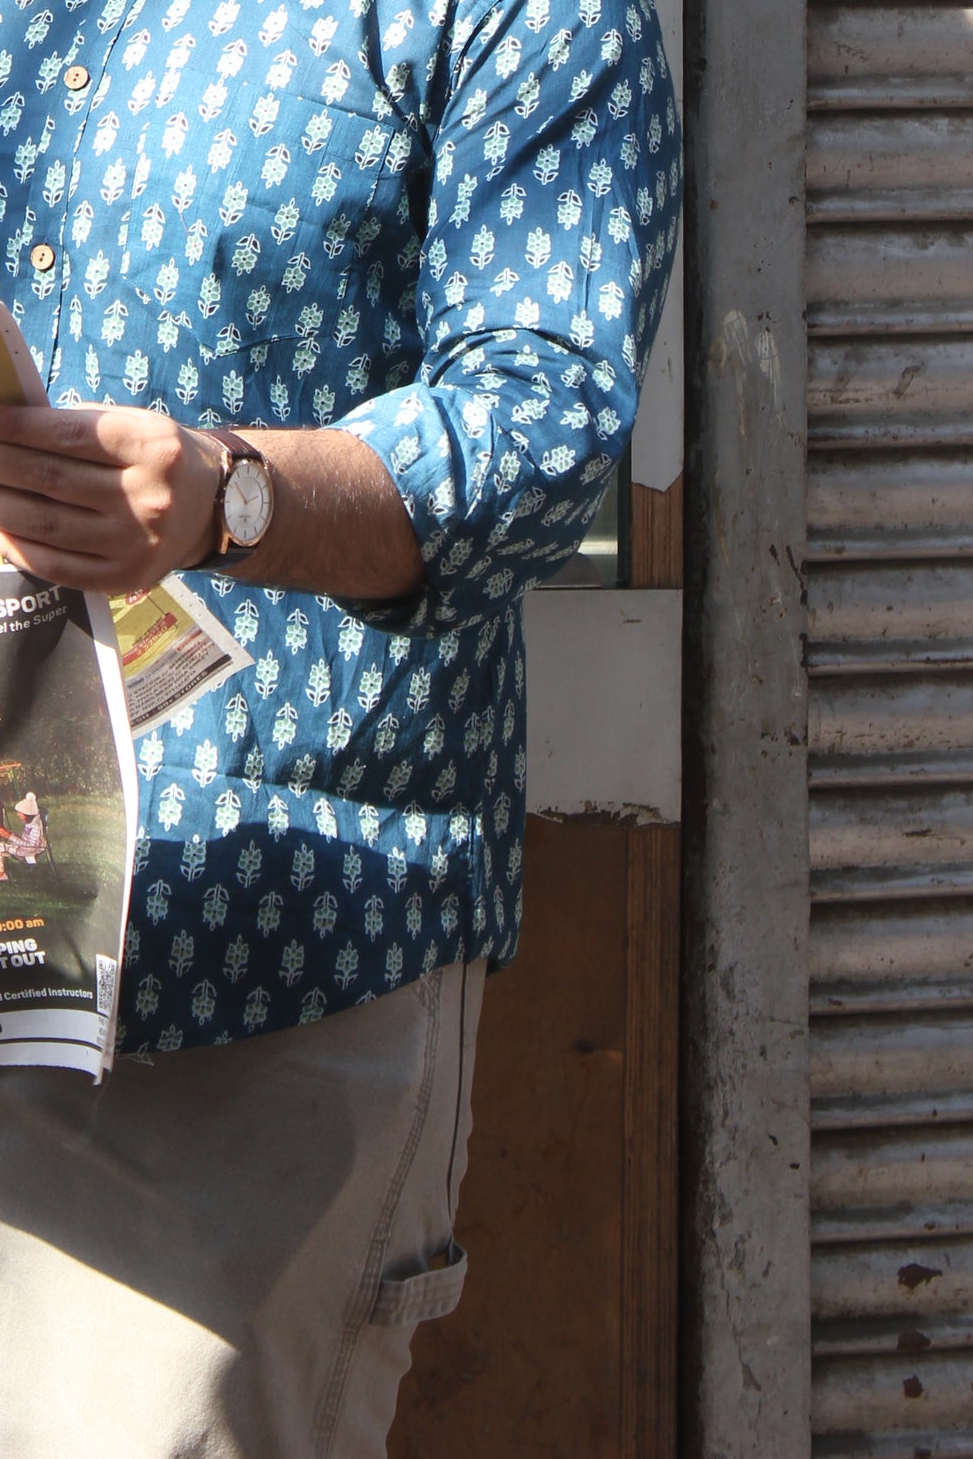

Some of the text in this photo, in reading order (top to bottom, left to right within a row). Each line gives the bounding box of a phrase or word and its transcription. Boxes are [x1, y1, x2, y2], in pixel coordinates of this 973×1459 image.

[9, 619, 31, 632] the
[33, 605, 67, 625] Super
[25, 917, 45, 928] am
[10, 951, 46, 968] OUT
[4, 989, 47, 1001] Certified
[48, 988, 94, 1000] Instructors
